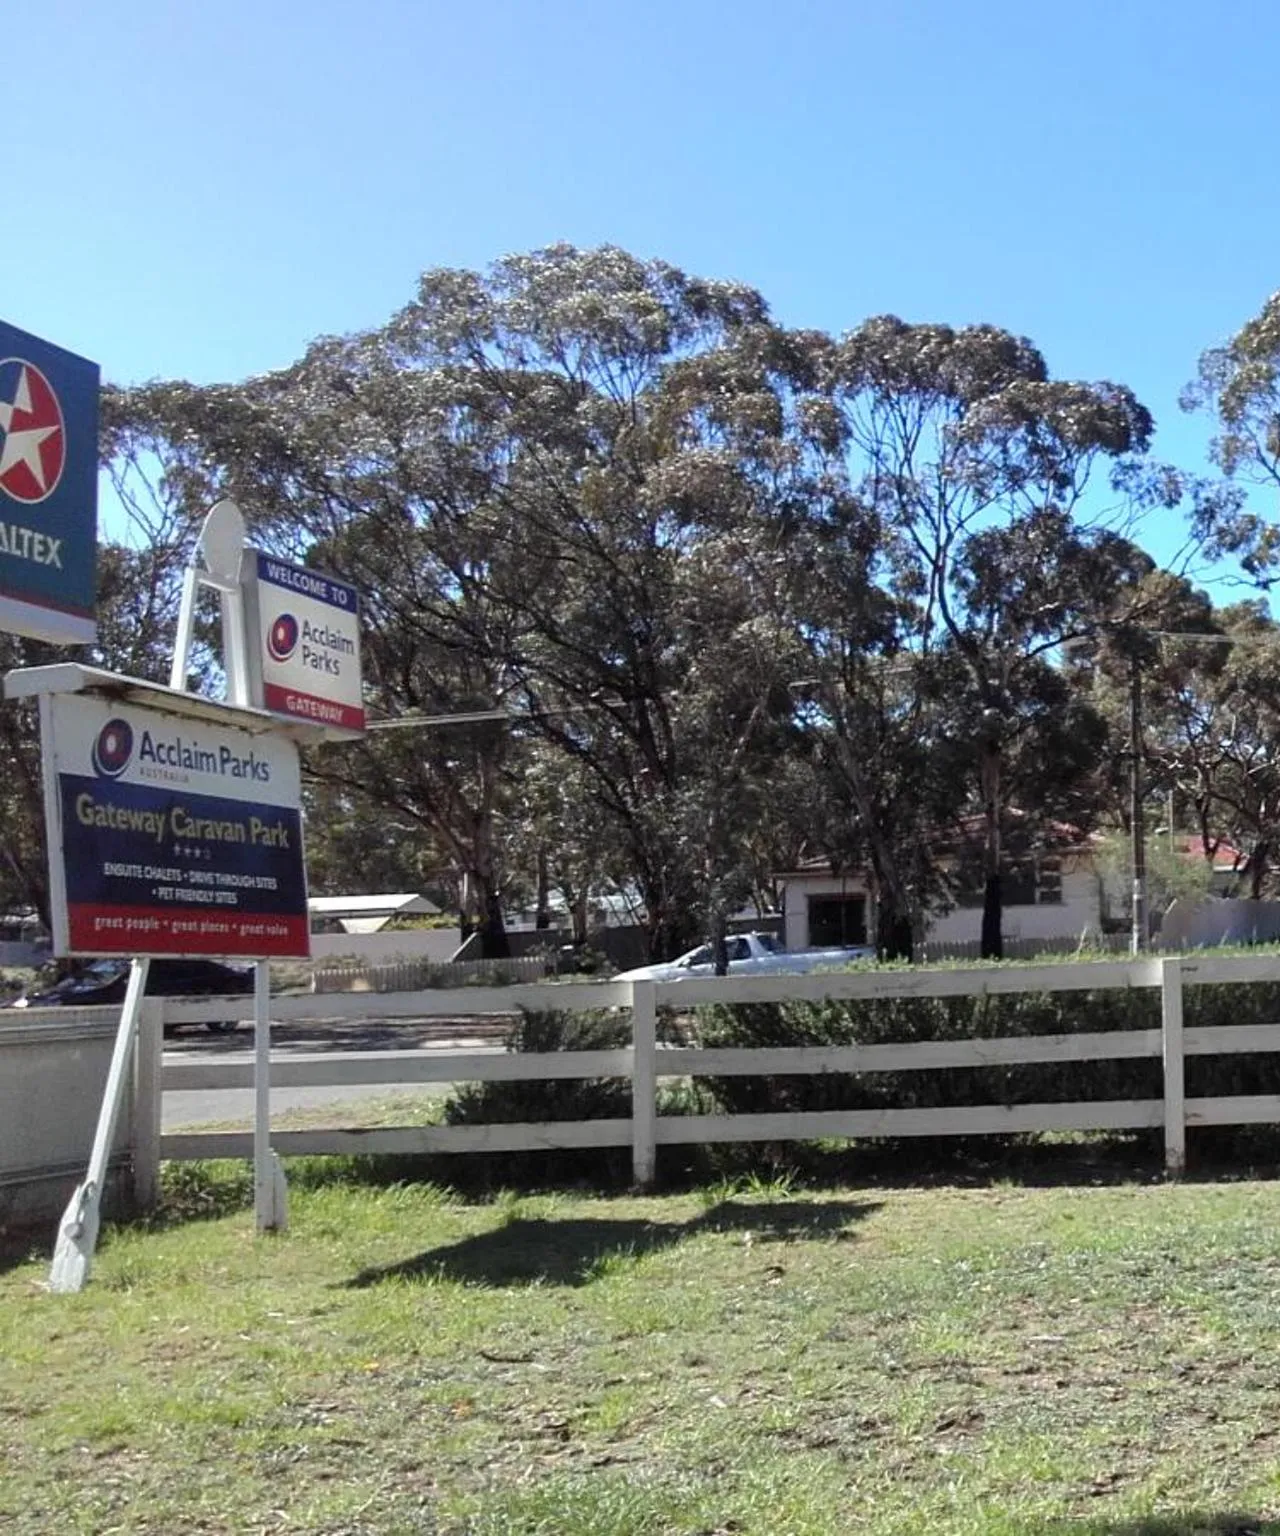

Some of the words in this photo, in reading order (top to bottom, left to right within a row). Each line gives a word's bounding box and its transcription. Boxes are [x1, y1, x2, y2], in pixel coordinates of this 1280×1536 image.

[267, 561, 328, 599] WELCOME
[332, 586, 348, 605] TO
[302, 619, 355, 656] Acclaim
[302, 645, 340, 676] Parks
[285, 695, 345, 723] GATEWAY
[139, 730, 217, 773] Acclaim
[219, 745, 270, 782] Parks
[139, 766, 190, 783] AUSTRALIA
[75, 792, 166, 843] Gateway
[170, 806, 246, 843] Caravan
[250, 815, 290, 848] Park
[104, 861, 142, 879] ENSUITE
[144, 865, 182, 882] CHALETS
[189, 870, 214, 885] DRIVE
[215, 873, 255, 889] THROUGH
[256, 876, 278, 890] SITES
[158, 886, 174, 900] PET
[175, 888, 213, 903] FRIENDLY
[215, 891, 238, 904] SITES
[95, 917, 123, 931] great
[126, 916, 159, 933] people
[172, 920, 197, 934] great
[201, 919, 229, 935] places
[240, 923, 264, 937] great
[267, 923, 288, 937] value
